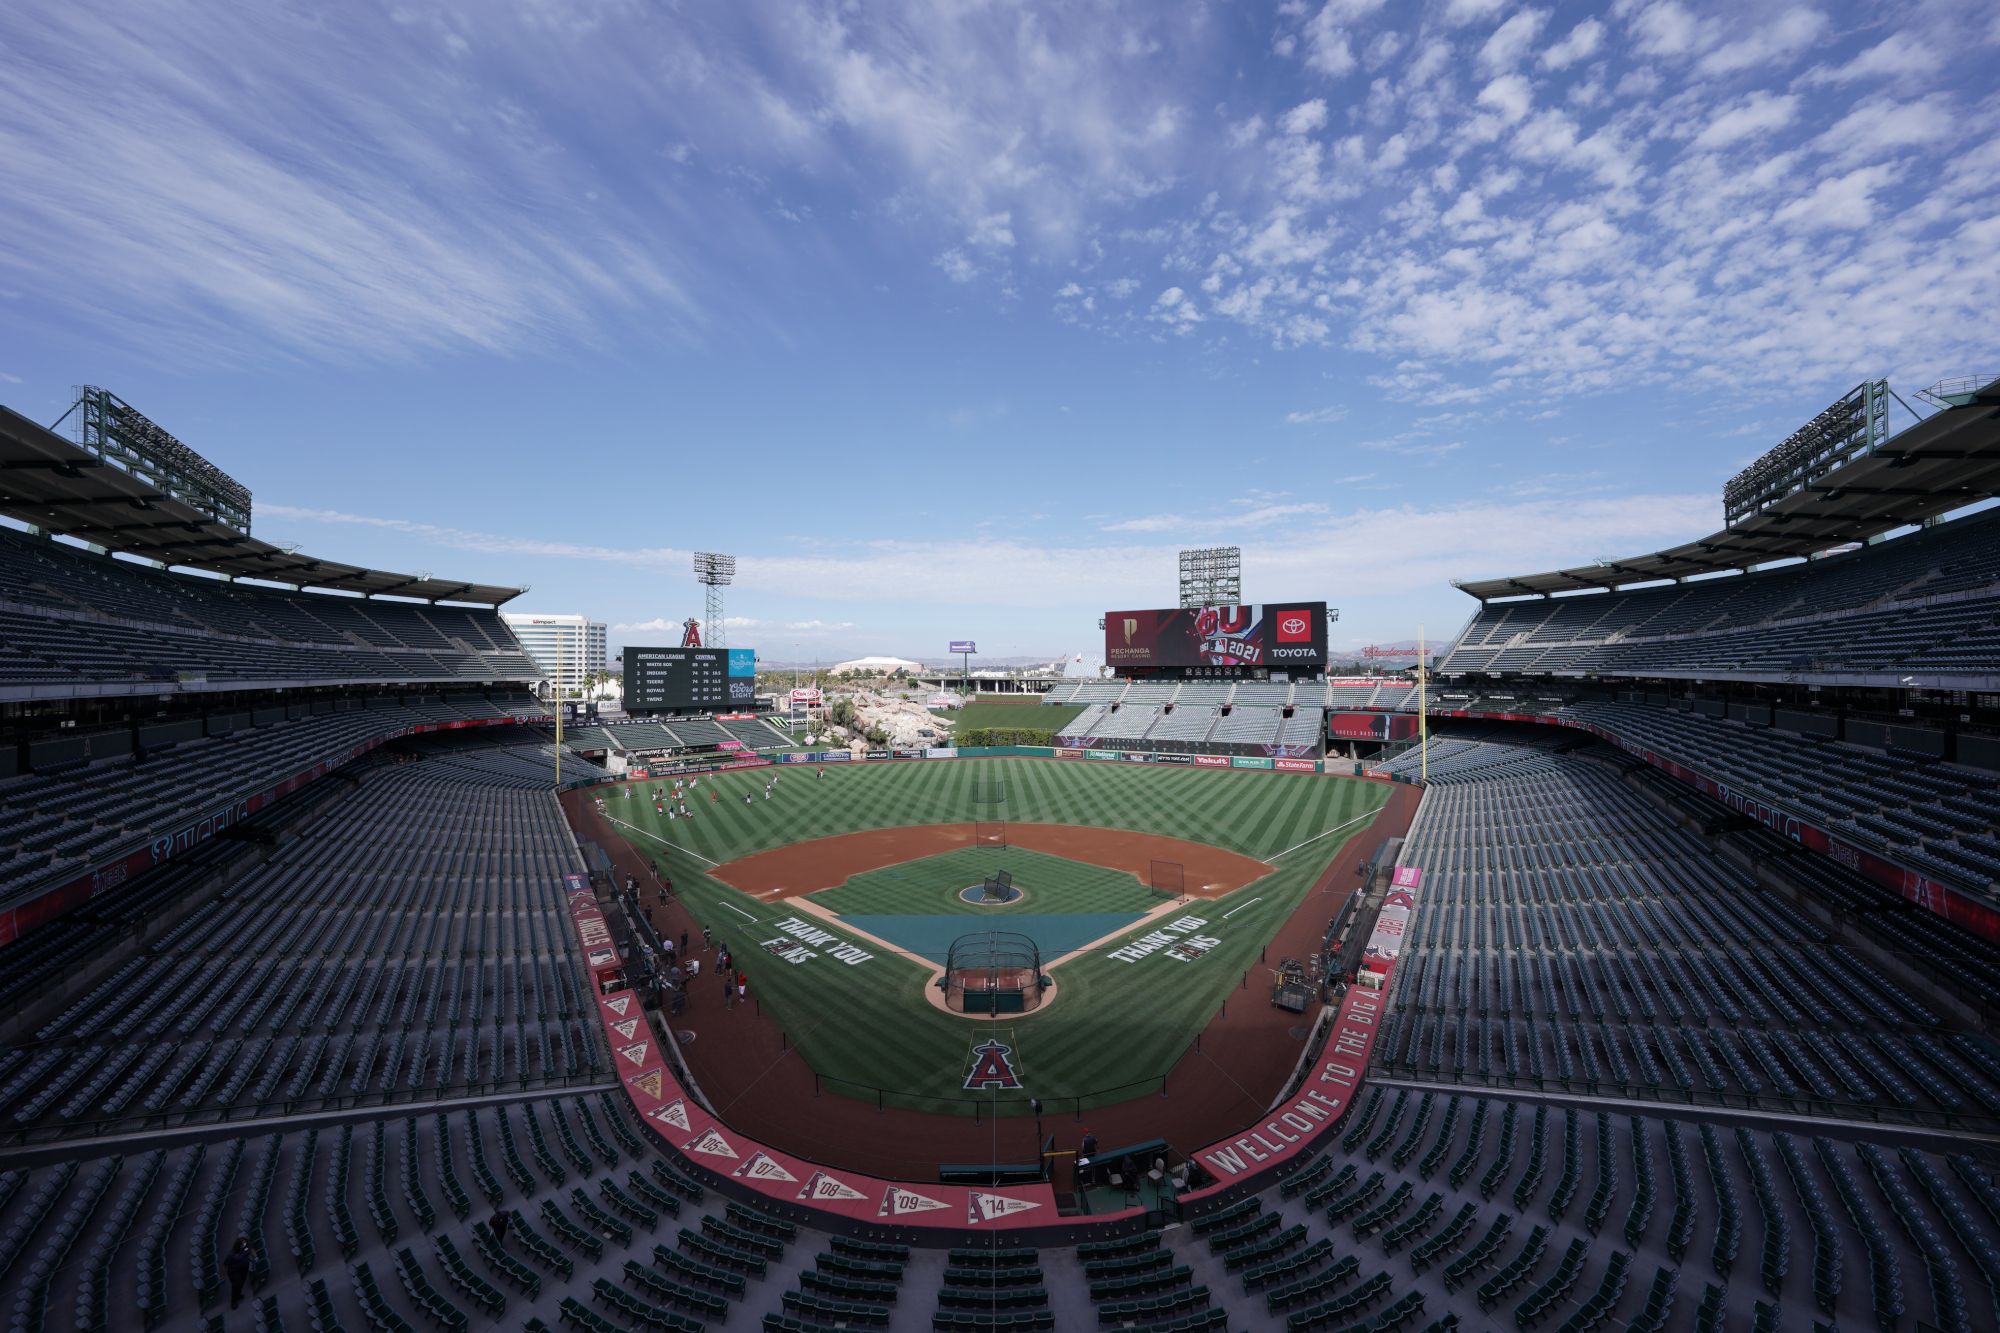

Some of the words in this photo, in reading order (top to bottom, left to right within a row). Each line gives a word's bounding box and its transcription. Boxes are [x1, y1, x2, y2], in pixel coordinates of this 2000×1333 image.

[1228, 641, 1260, 662] 2021
[1272, 648, 1317, 658] TOYOTA
[730, 683, 754, 693] Coors
[578, 918, 610, 946] ANGELS
[774, 917, 839, 948] THANK
[825, 942, 874, 965] YOU
[1106, 930, 1180, 963] THANK
[1163, 915, 1208, 933] YOU
[760, 936, 818, 964] FANS
[1164, 935, 1222, 962] FANS
[1356, 990, 1380, 1000] A
[1348, 1001, 1378, 1025] BIG
[1335, 1028, 1368, 1056] THE
[1320, 1062, 1356, 1086] TO
[1205, 1090, 1340, 1175] WELCOME
[702, 1138, 722, 1151] '05
[755, 1161, 776, 1176] '07
[820, 1182, 840, 1196] '08
[899, 1196, 919, 1209] '09
[985, 1200, 1005, 1213] '14
